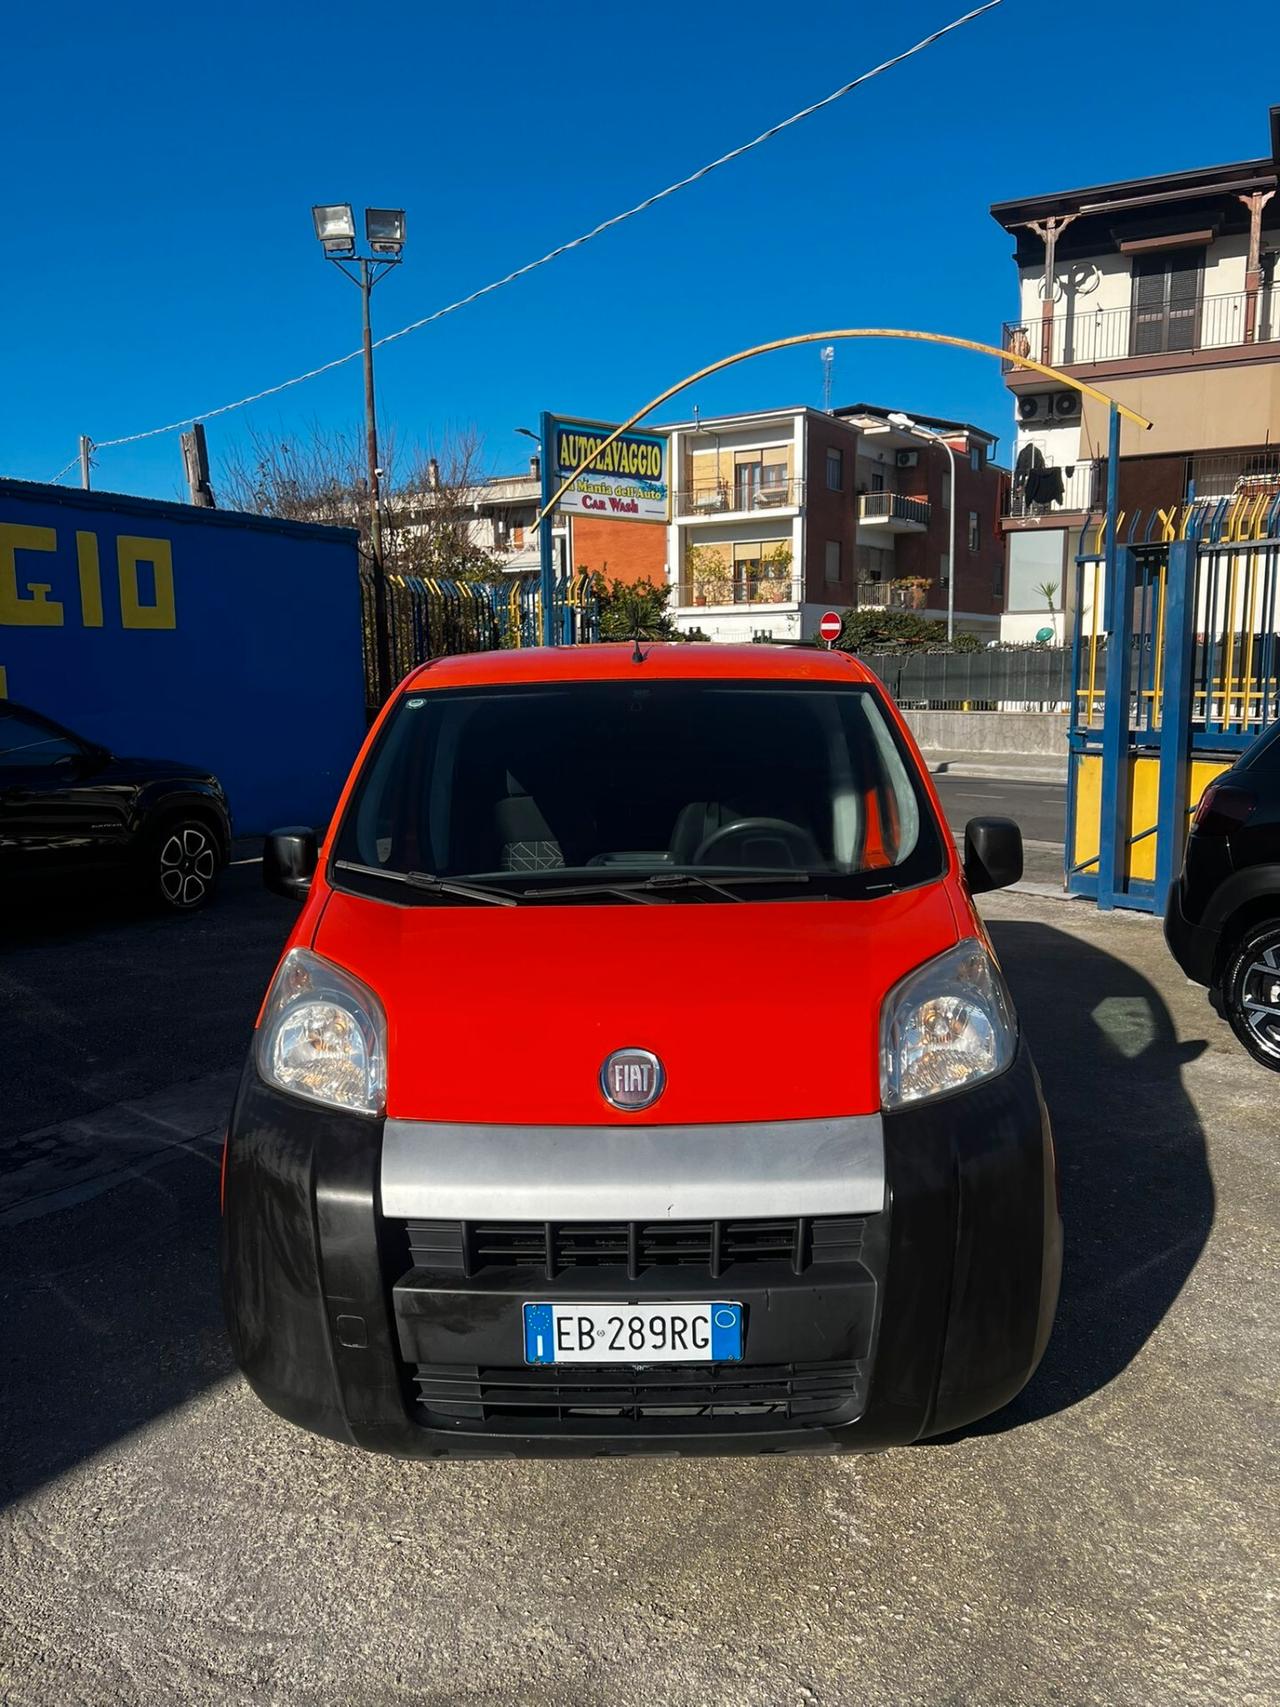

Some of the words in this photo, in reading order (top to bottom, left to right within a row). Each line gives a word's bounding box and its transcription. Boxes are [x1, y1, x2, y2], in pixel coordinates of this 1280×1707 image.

[560, 433, 661, 477] AUTOLAVAGGIO
[577, 480, 612, 495] Mania
[0, 522, 177, 629] GIO
[615, 1064, 651, 1092] FIAT
[556, 1316, 595, 1351] EB
[607, 1316, 709, 1351] 289RG
